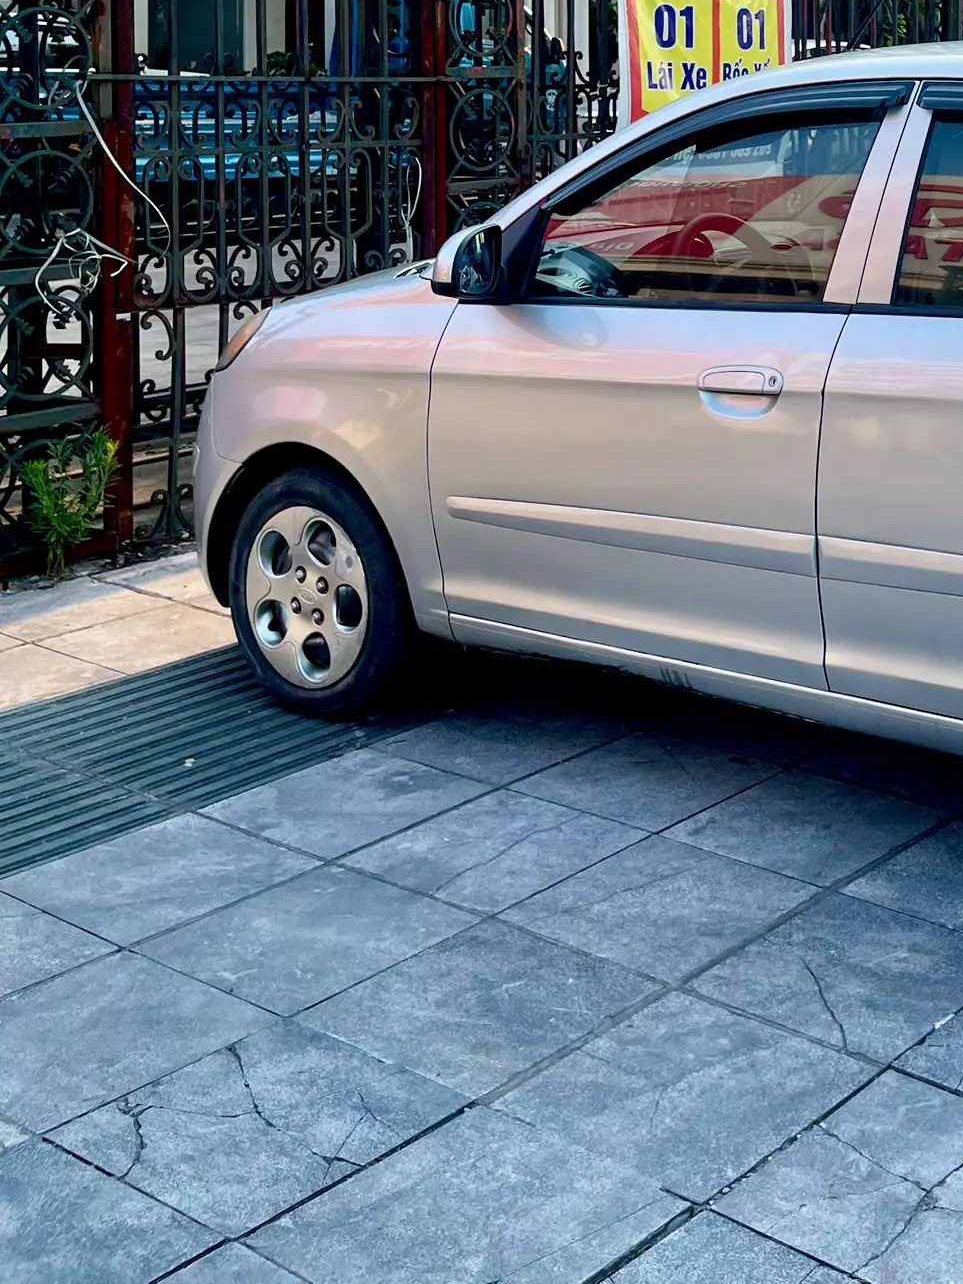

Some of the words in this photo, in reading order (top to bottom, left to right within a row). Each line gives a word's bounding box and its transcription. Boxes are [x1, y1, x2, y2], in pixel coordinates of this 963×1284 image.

[653, 4, 695, 49] 01
[735, 7, 766, 51] 01
[647, 60, 674, 91] Lái
[680, 62, 707, 91] Xe
